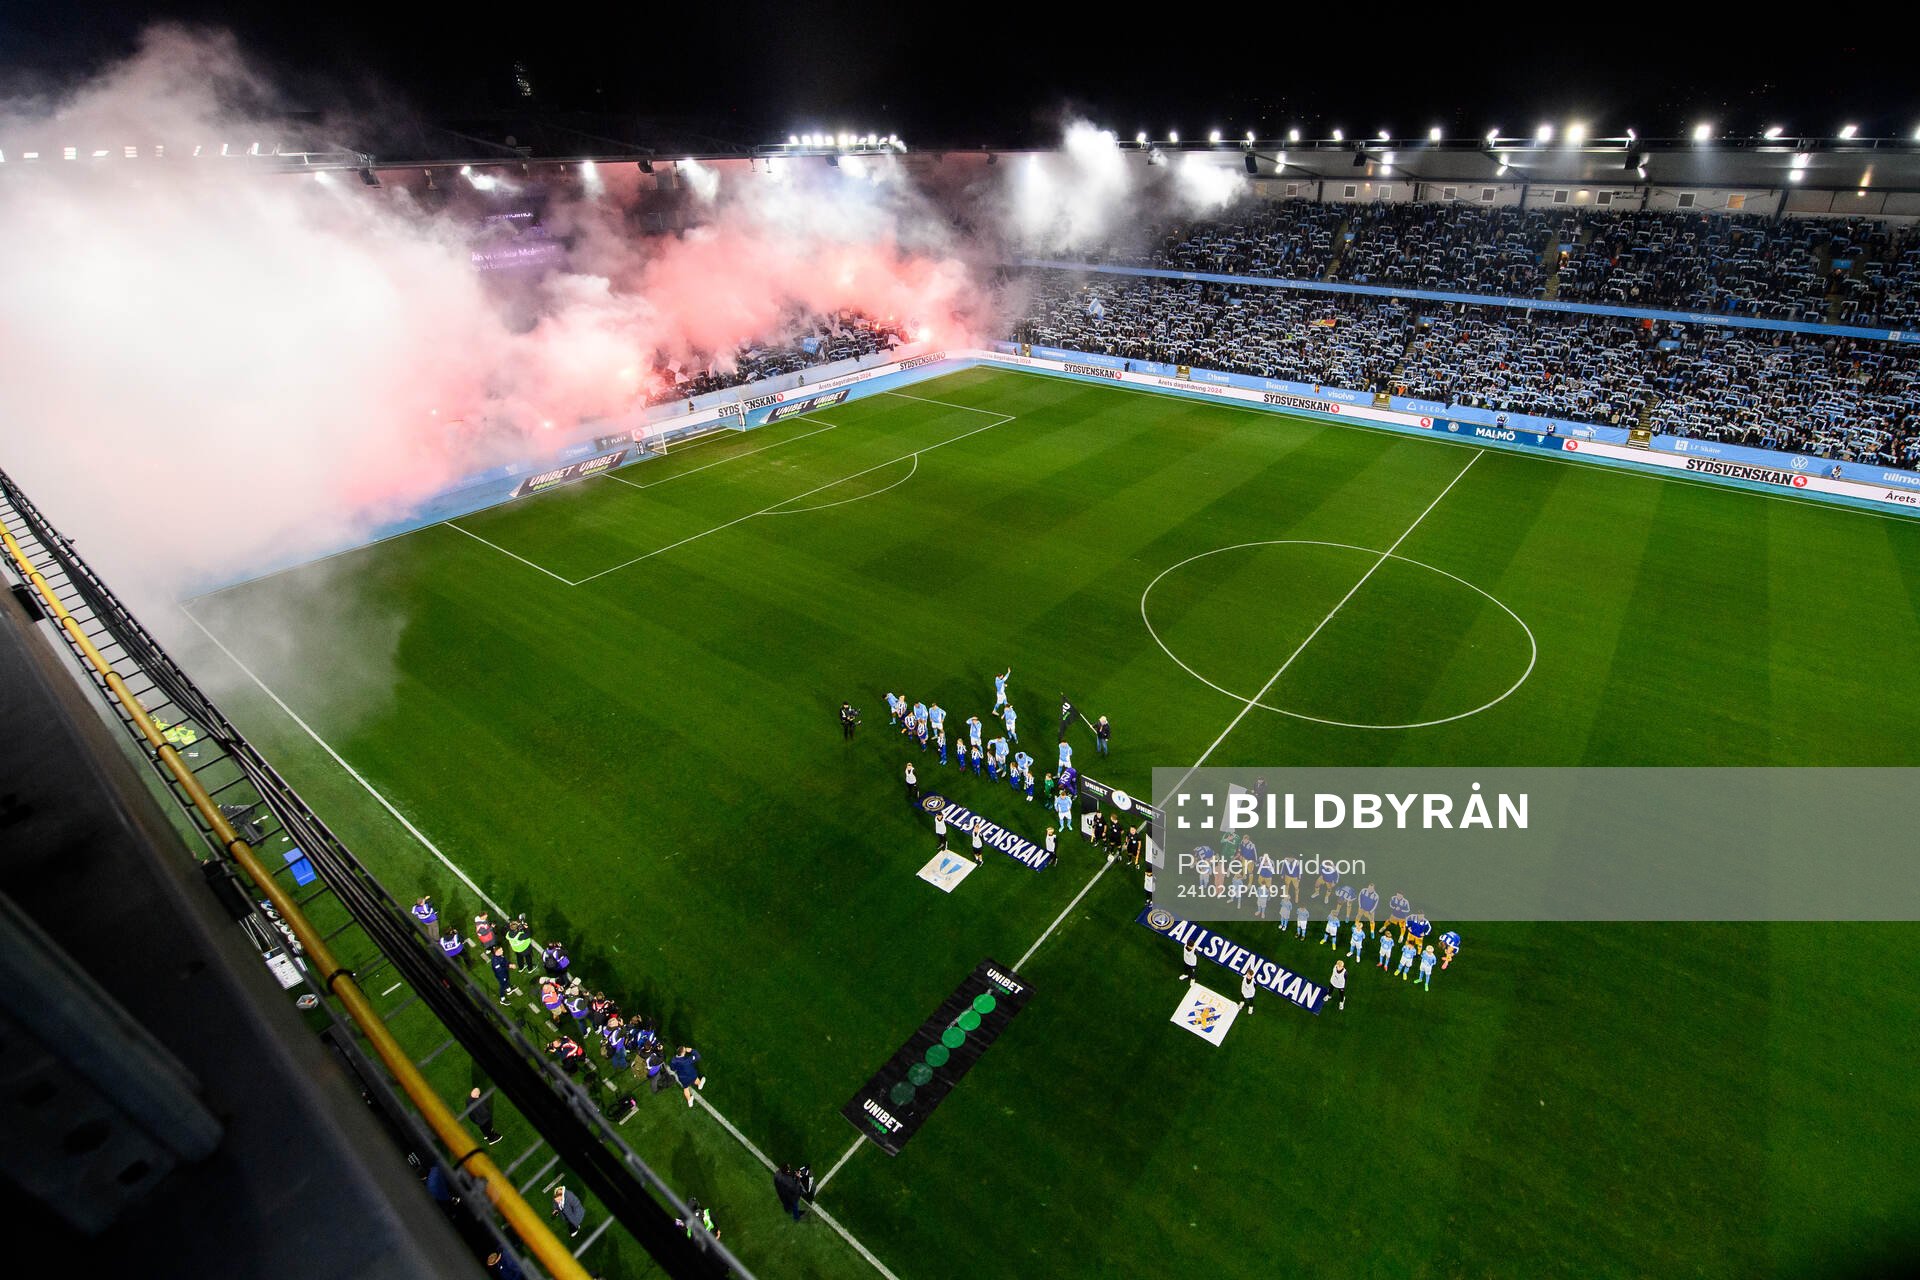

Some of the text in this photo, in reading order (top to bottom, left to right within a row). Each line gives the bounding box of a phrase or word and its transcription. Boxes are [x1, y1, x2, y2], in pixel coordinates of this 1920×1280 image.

[1064, 363, 1115, 378] SYDSVENSKAN
[718, 394, 777, 417] SYDSENSKAN
[775, 400, 810, 416] UNIBET
[813, 390, 845, 406] UNIBET
[1264, 393, 1330, 412] SYDSVENSKAN
[1475, 427, 1516, 442] MALMÖ
[578, 451, 622, 473] UNIBET
[1686, 458, 1794, 486] SYDSVENSKAN
[529, 465, 575, 487] UNIBET
[1883, 472, 1920, 485] tillmo
[1885, 490, 1917, 504] Årets
[1084, 781, 1108, 796] UNIBET
[941, 803, 1051, 869] ALLSVENSKAN
[1168, 919, 1322, 1009] ALLSVENSKAN
[986, 968, 1024, 995] UNIBET
[863, 1098, 904, 1133] UNIBET
